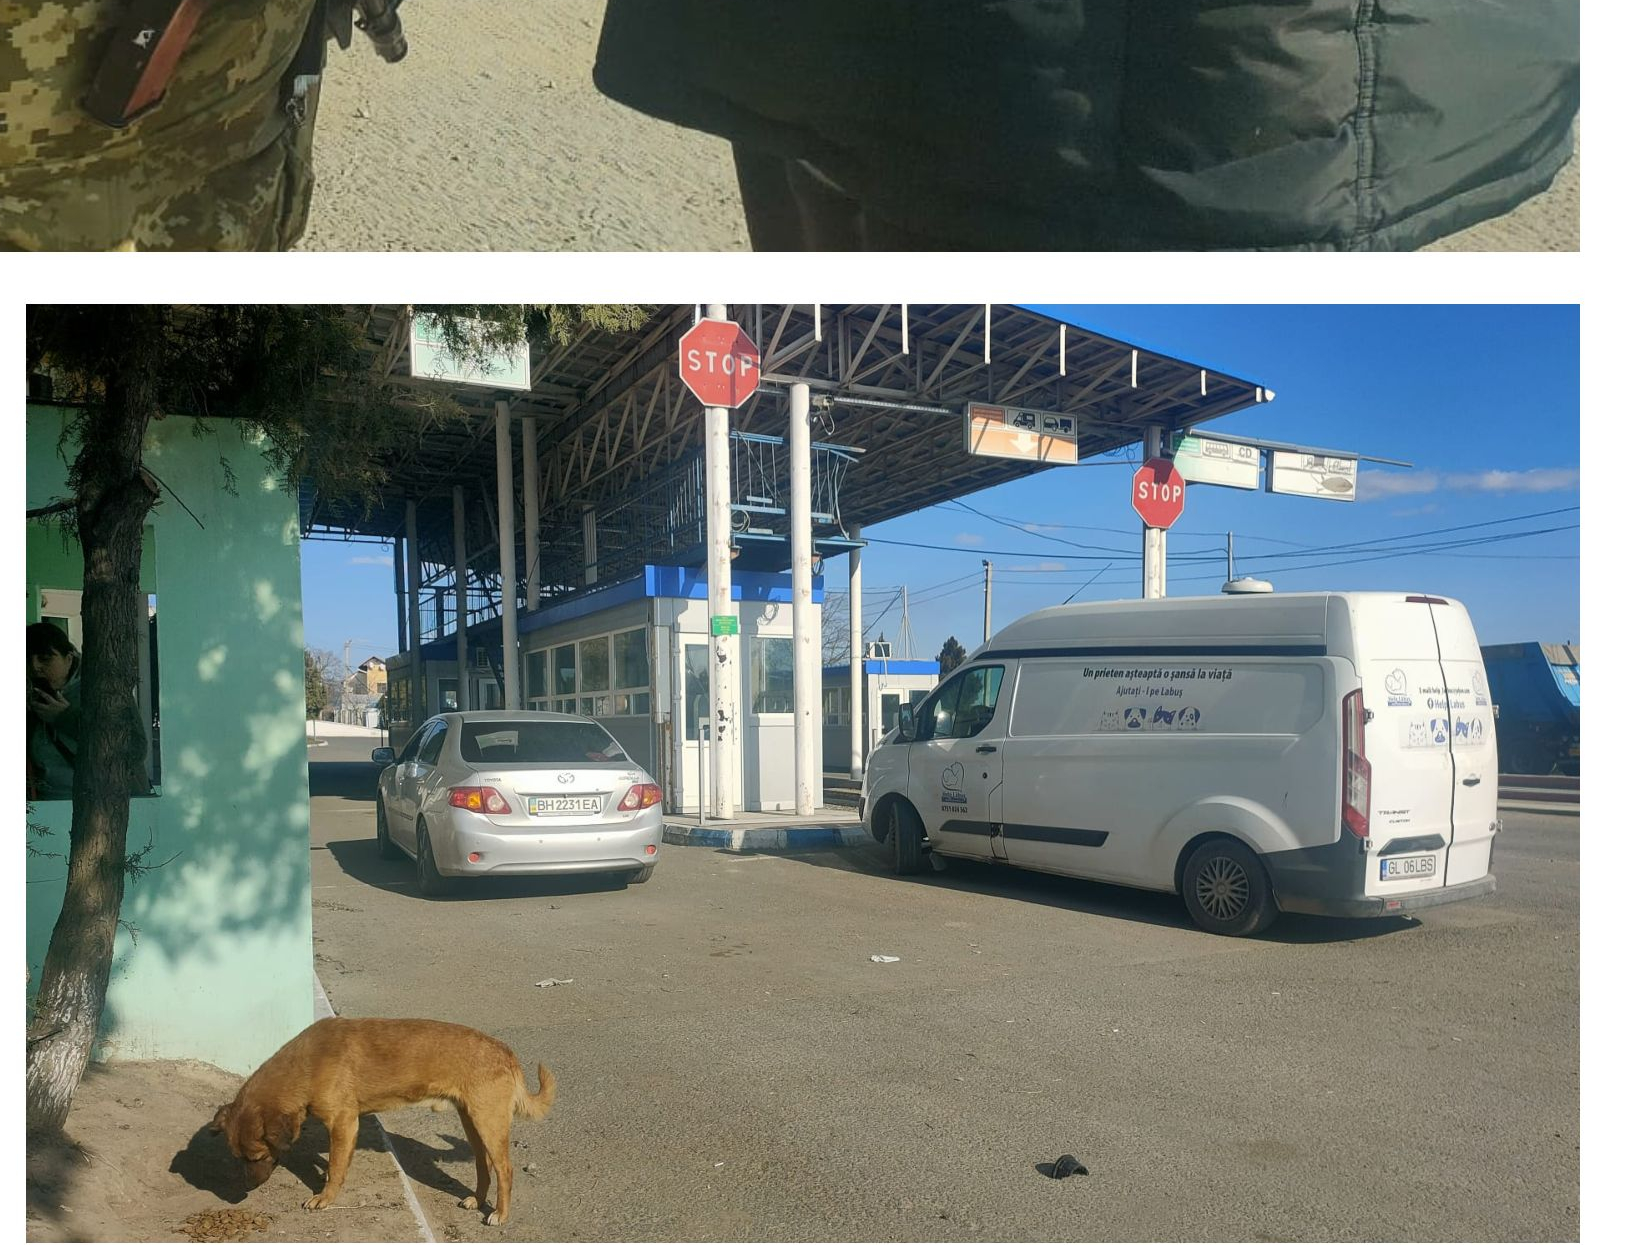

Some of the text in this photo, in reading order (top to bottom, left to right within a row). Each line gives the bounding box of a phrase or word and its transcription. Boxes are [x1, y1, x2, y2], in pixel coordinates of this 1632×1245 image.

[688, 349, 753, 377] STOP
[1238, 446, 1253, 459] CD
[1138, 481, 1182, 503] STOP
[1083, 668, 1093, 678] Un
[1094, 668, 1123, 680] prieten
[1163, 670, 1169, 678] o
[1198, 668, 1206, 680] la
[1388, 861, 1400, 875] GL
